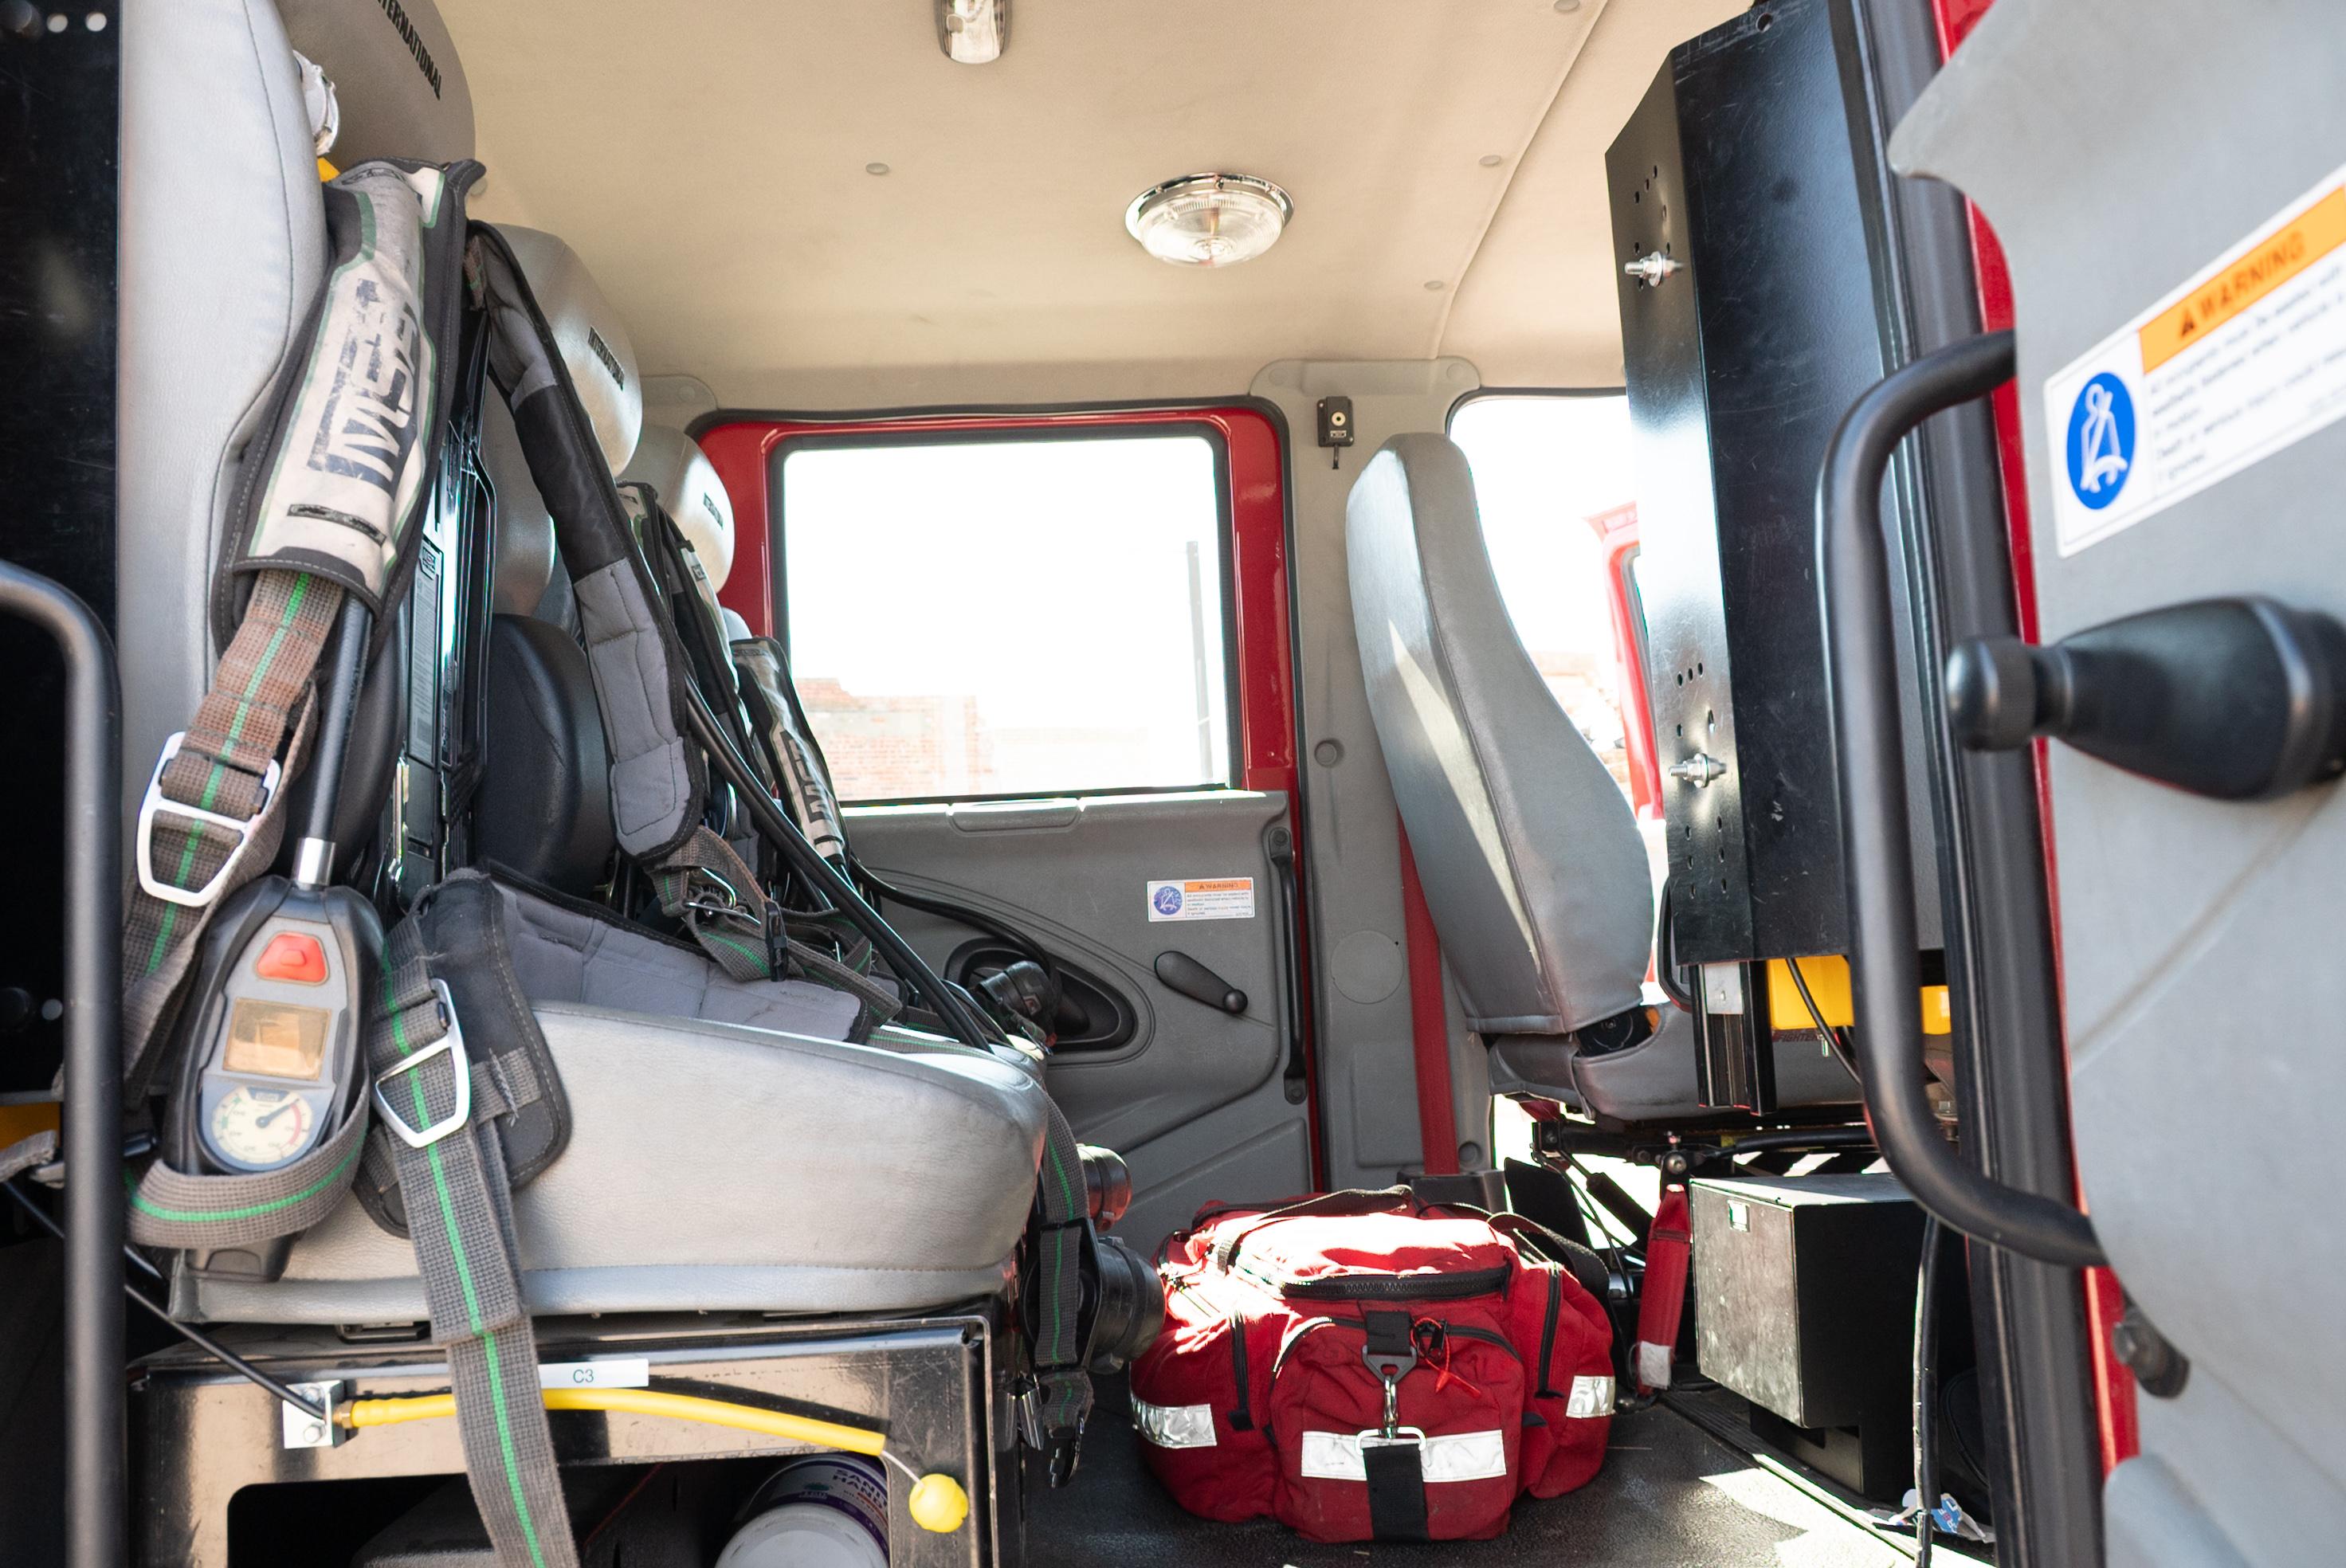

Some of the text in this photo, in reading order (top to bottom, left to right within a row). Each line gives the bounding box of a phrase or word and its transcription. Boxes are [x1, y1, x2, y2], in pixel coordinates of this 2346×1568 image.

[2199, 229, 2305, 320] WARNING
[309, 280, 421, 496] MSA
[573, 1369, 594, 1383] C3
